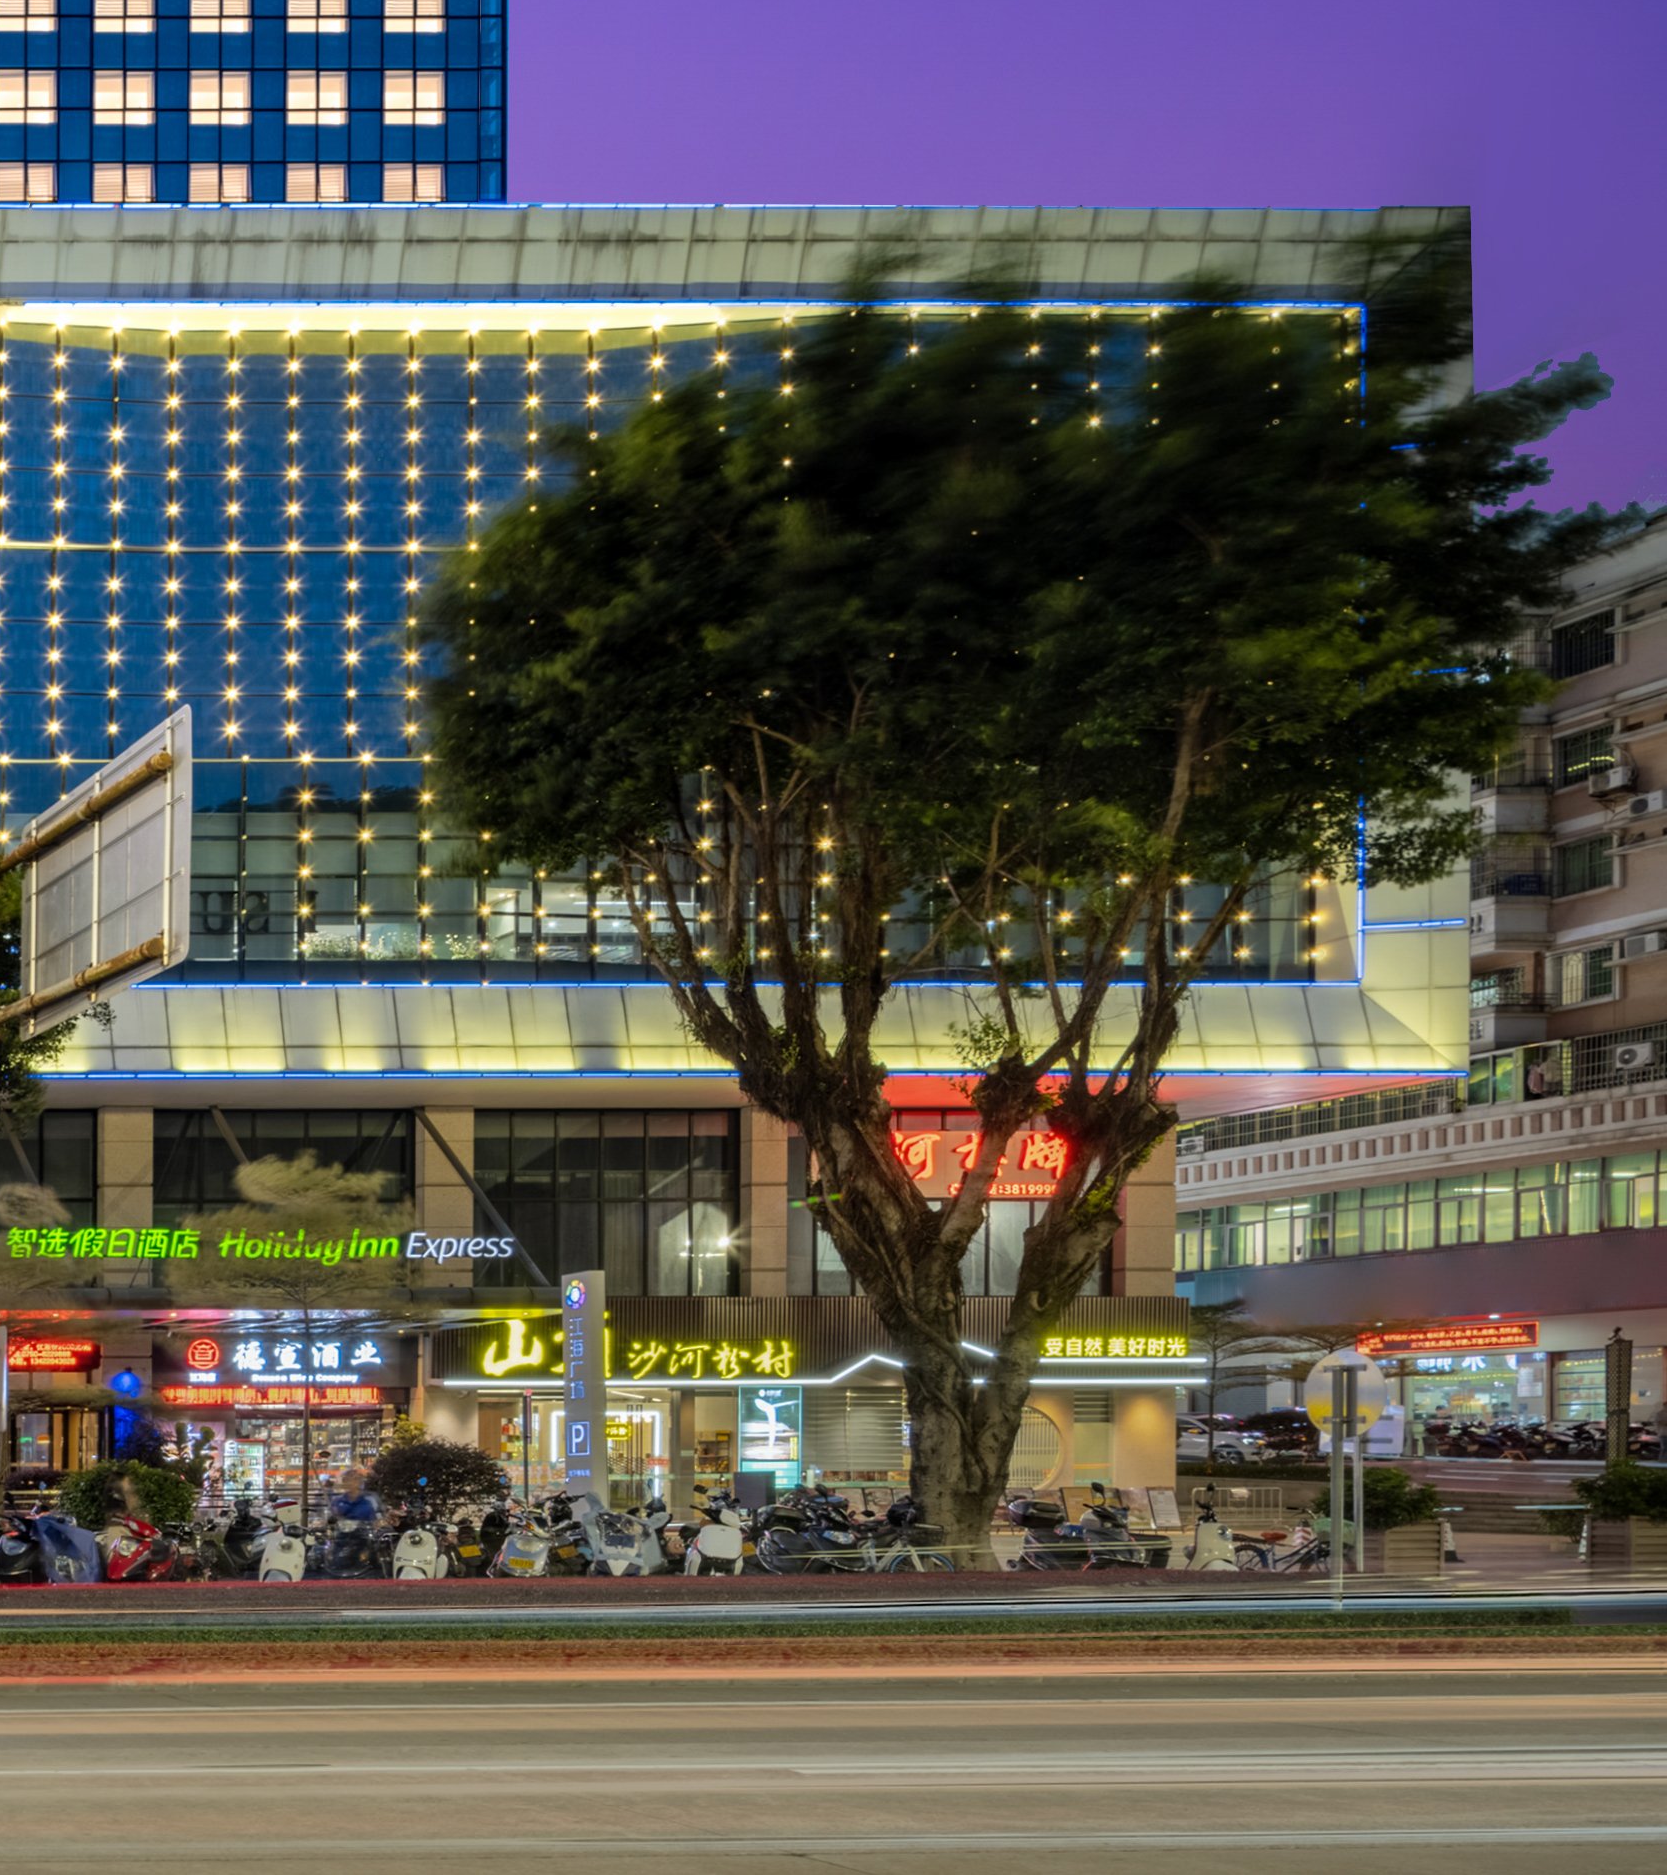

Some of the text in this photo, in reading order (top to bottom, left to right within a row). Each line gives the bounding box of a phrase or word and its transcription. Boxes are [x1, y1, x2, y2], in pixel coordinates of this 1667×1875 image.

[7, 1226, 201, 1258] 智选假日酒店
[348, 1227, 399, 1258] Inn
[405, 1231, 514, 1265] Express
[569, 1318, 585, 1400] 江海广场
[1107, 1337, 1187, 1357] 美好时光
[572, 1425, 585, 1453] P
